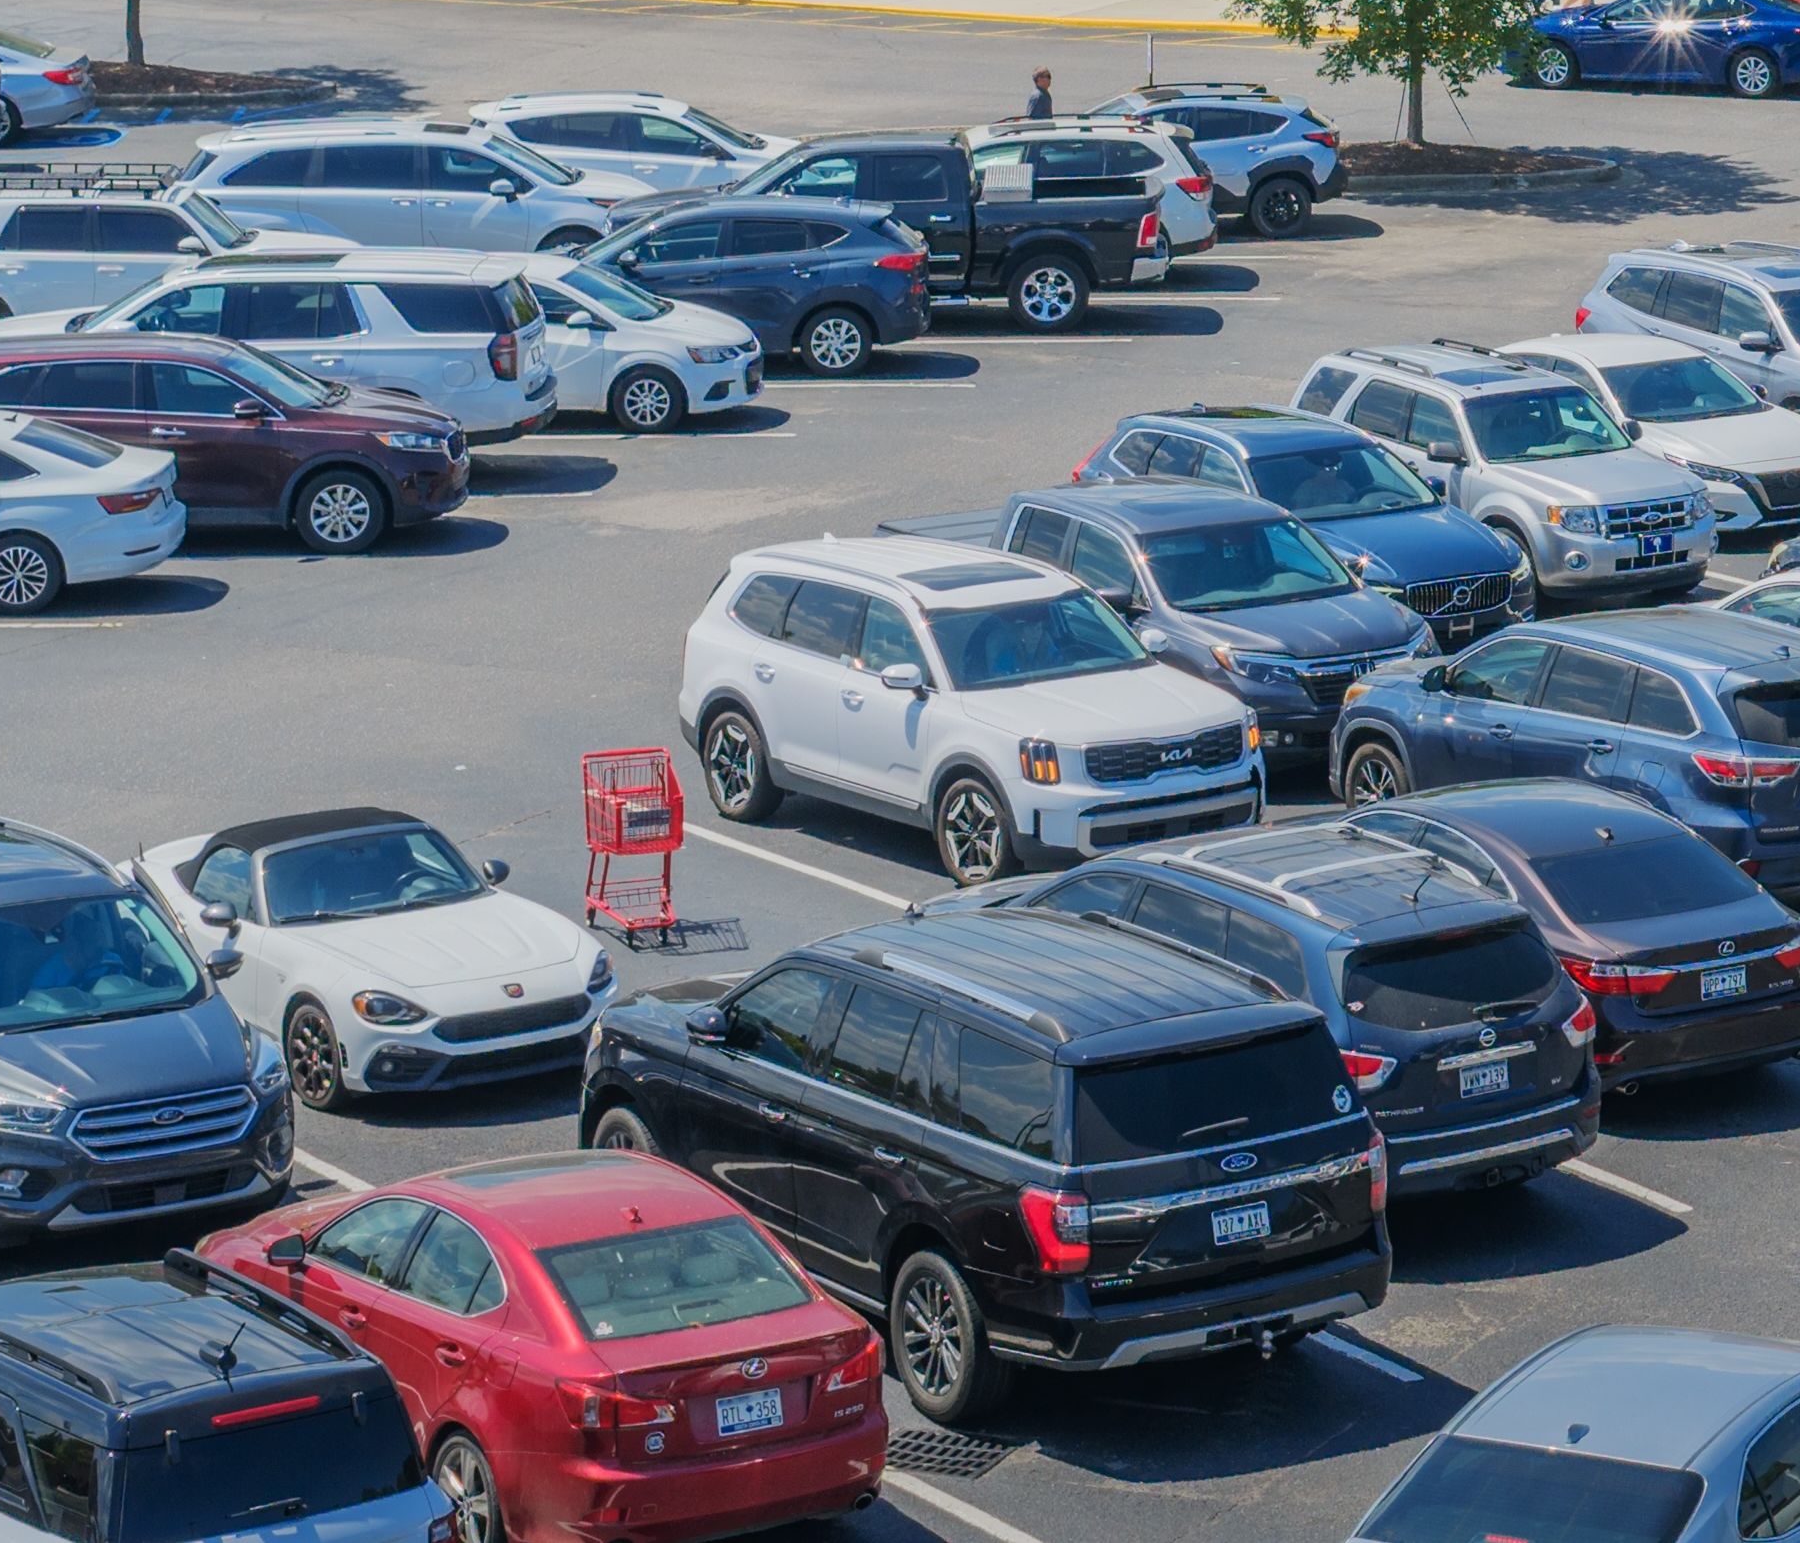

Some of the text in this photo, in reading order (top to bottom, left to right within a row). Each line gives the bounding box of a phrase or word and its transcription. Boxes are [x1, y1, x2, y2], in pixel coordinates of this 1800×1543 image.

[1488, 1068, 1505, 1083] 139
[1375, 1106, 1424, 1118] PATHFINDER
[1217, 1213, 1266, 1234] 137 AXL
[722, 1399, 777, 1425] RTL 358
